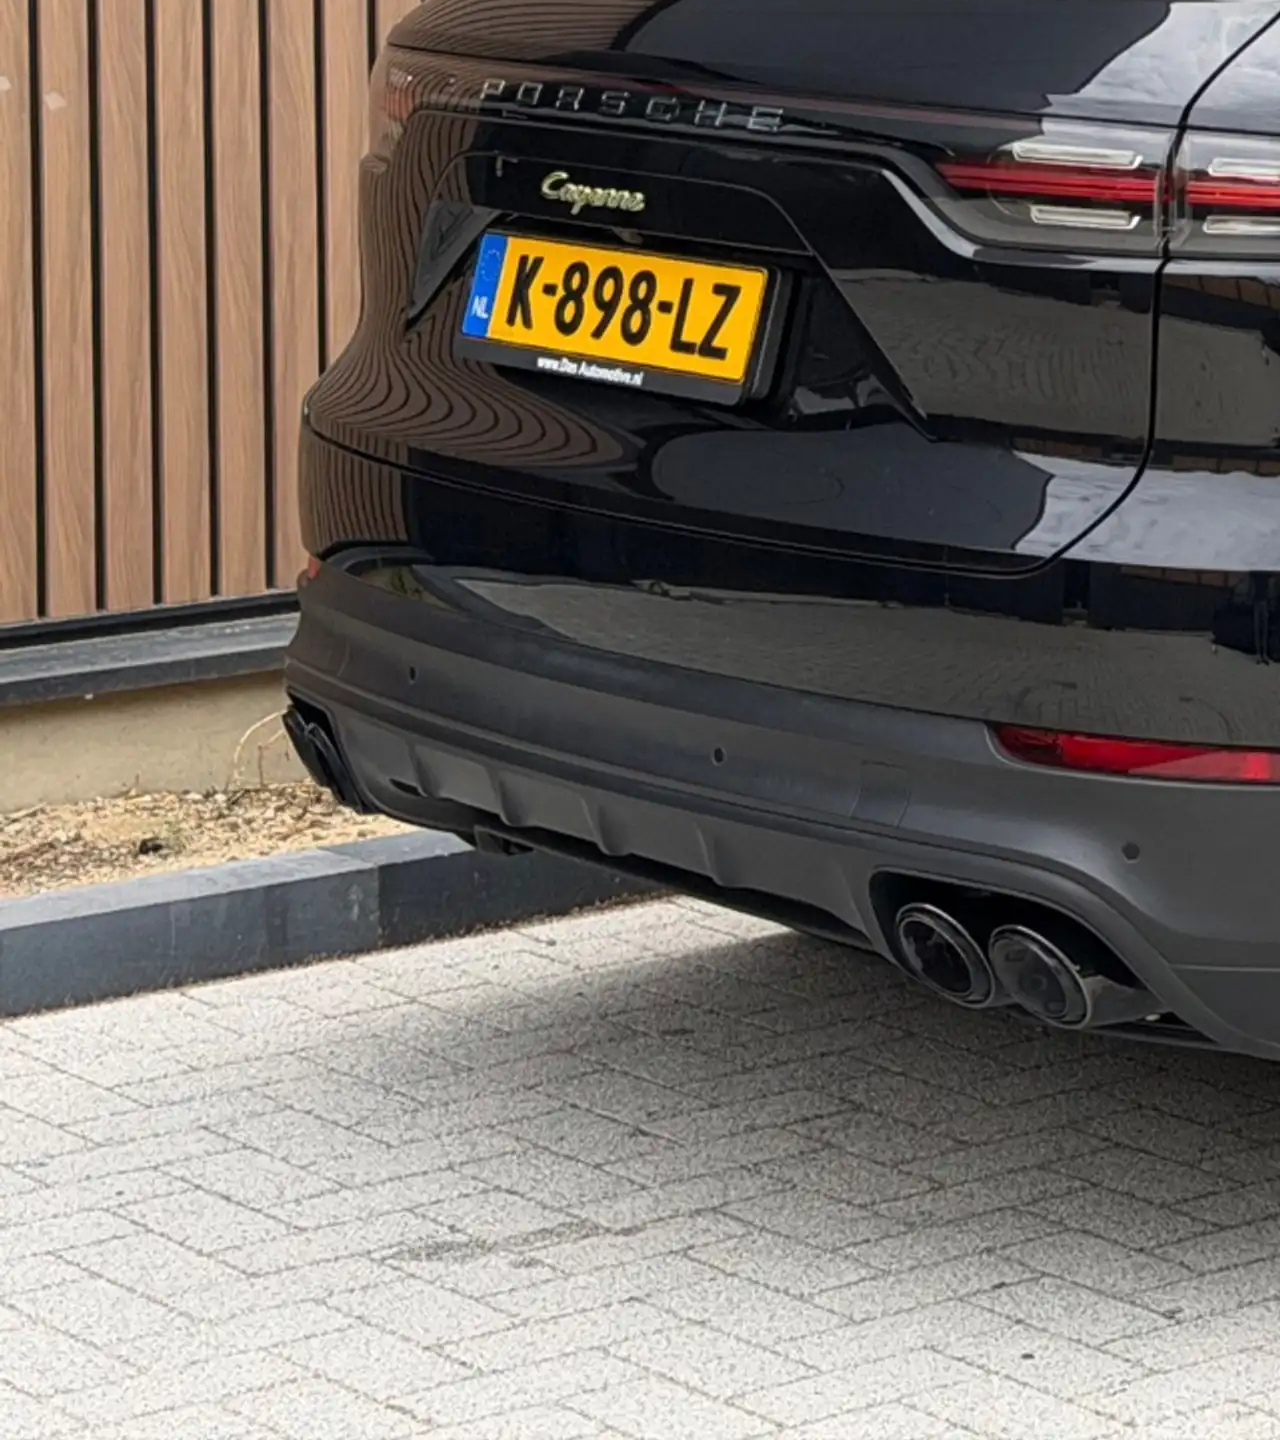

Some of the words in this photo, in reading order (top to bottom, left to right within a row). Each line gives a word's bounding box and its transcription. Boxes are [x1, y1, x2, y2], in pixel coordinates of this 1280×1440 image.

[480, 79, 785, 133] PORSCHE
[541, 171, 645, 215] Cayenne
[471, 295, 489, 318] NL
[505, 254, 741, 361] K-898-LZ
